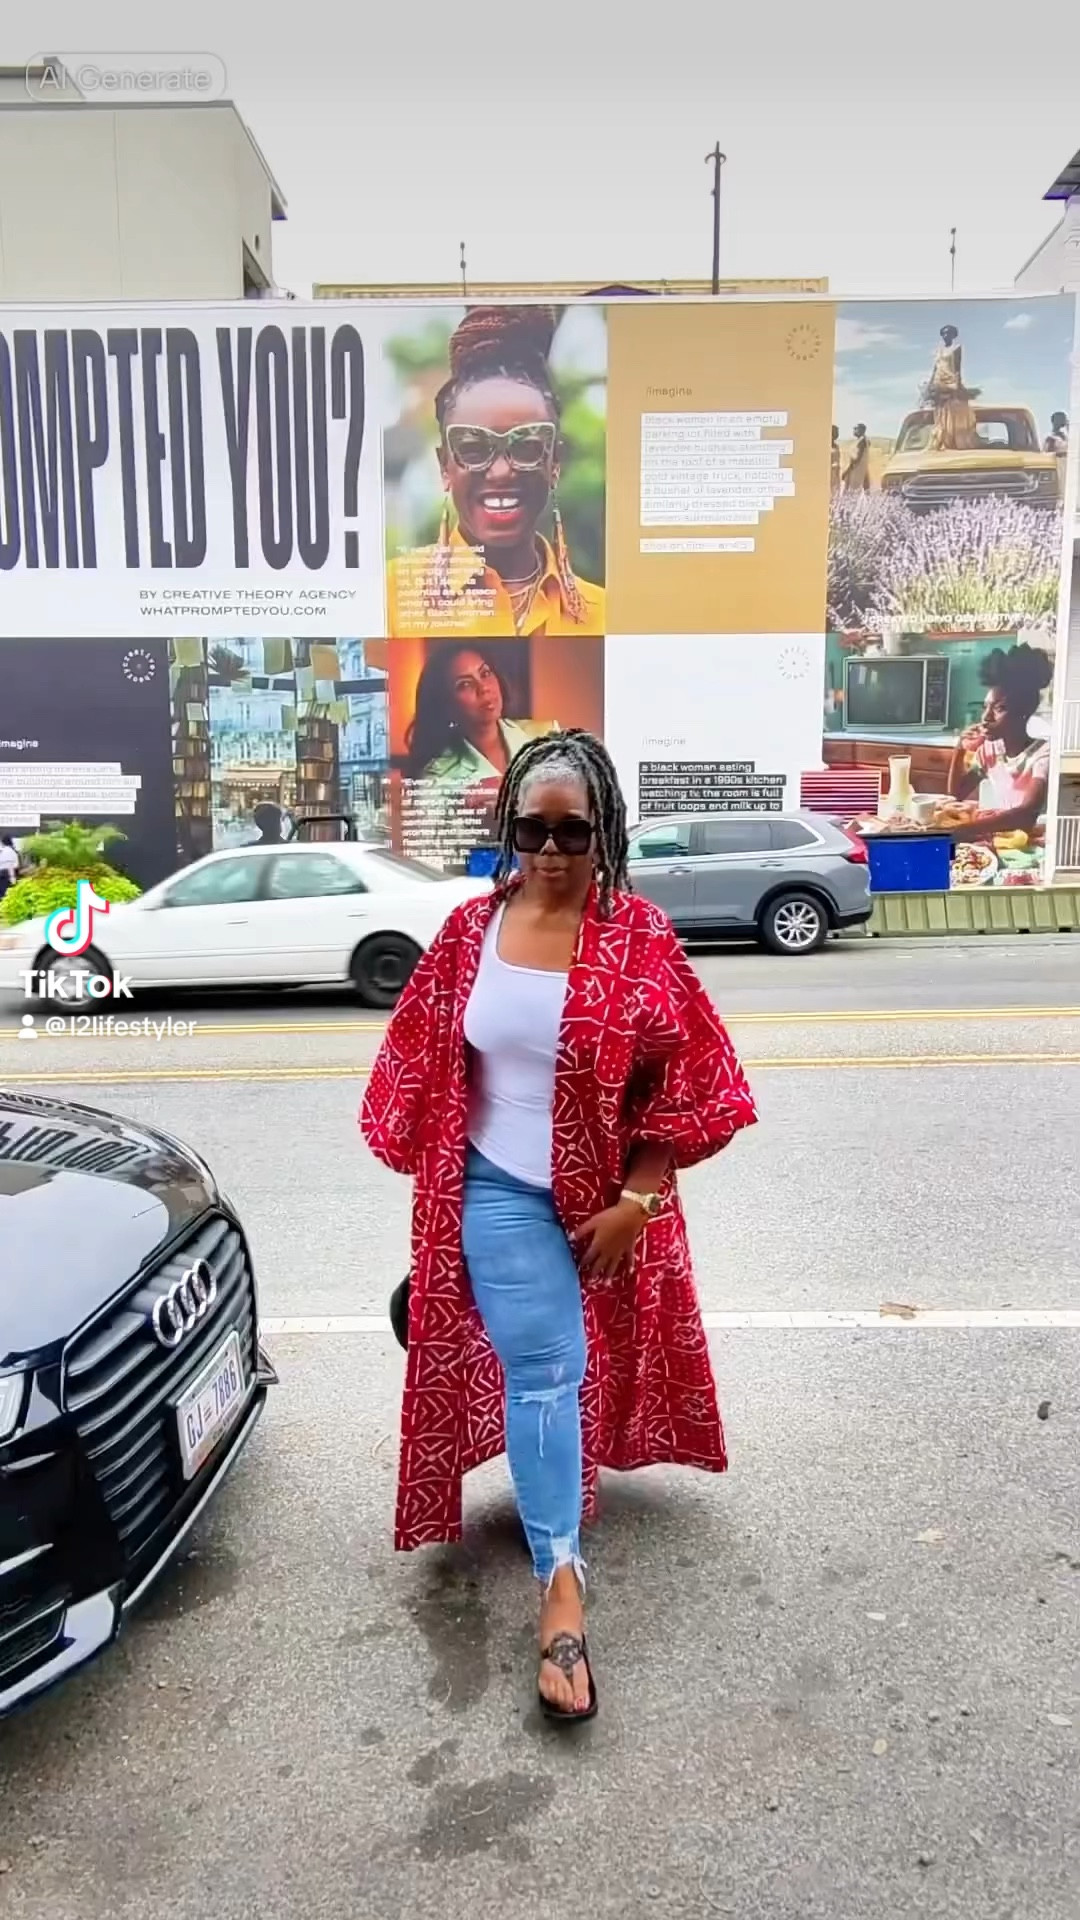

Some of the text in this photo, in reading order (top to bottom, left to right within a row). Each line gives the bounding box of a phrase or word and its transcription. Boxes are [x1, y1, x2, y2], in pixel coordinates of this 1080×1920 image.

[216, 323, 366, 570] YOU?
[139, 589, 357, 601] BY CREATIVE THEORY AGENCY
[139, 605, 327, 616] WHATPROMPTEDYOU.COM
[650, 762, 679, 773] black
[680, 763, 718, 773] woman
[719, 762, 752, 773] eating
[641, 775, 690, 785] breakfast
[692, 774, 702, 785] in
[745, 774, 783, 785] kitchen
[641, 788, 688, 800] watching
[703, 788, 721, 798] the
[722, 788, 749, 798] room
[751, 787, 760, 798] is
[762, 787, 780, 798] full
[641, 800, 781, 813] of fruit loops and milk up to
